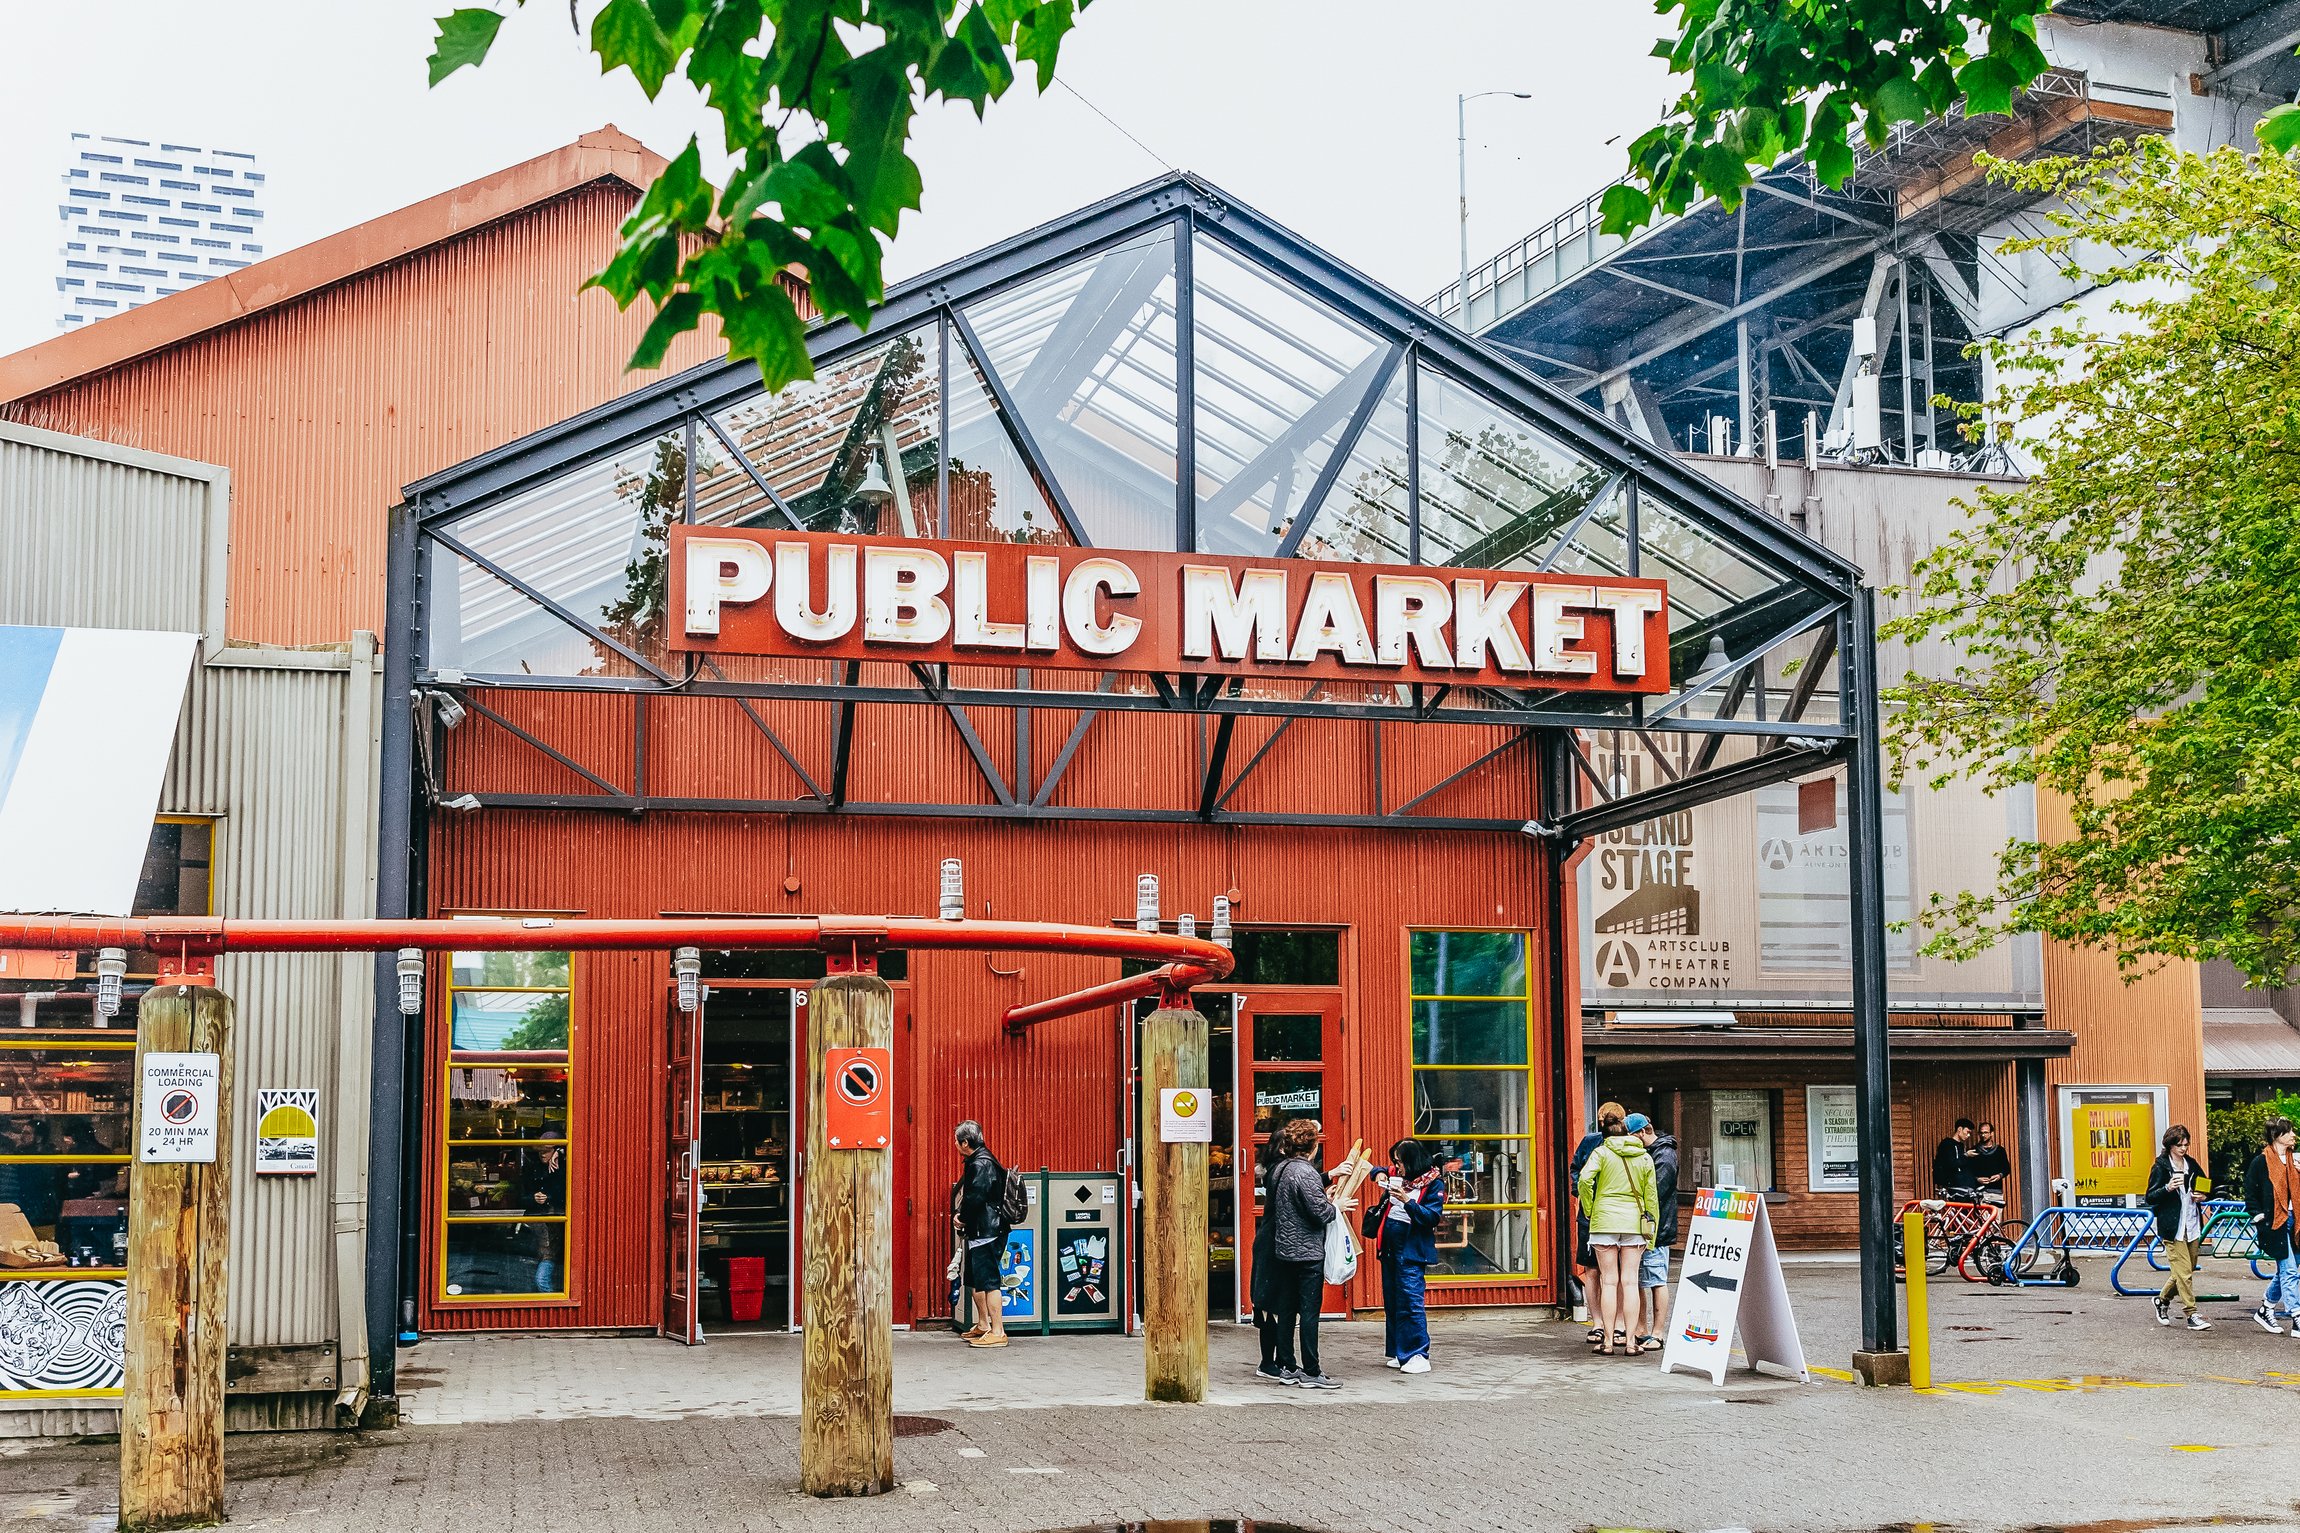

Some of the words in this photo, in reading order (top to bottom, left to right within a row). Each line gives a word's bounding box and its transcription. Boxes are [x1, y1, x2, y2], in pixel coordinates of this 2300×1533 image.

[685, 536, 1143, 655] PUBLIC
[1183, 563, 1662, 676] MARKET
[1600, 848, 1694, 890] STAGE
[1648, 939, 1730, 952] ARTSCLUB
[1648, 958, 1730, 970] THEATRE
[1649, 976, 1731, 988] COMPANY
[796, 990, 808, 1007] 6
[1237, 995, 1248, 1011] 7
[147, 1068, 214, 1078] COMMERCIAL
[158, 1078, 203, 1087] LOADING
[1257, 1096, 1280, 1105] PUBLIC
[1280, 1091, 1318, 1104] MARKET
[1828, 1117, 1849, 1125] SEASON
[1849, 1117, 1856, 1125] OF
[2089, 1110, 2129, 1128] MILLION
[148, 1127, 161, 1136] 20
[164, 1127, 184, 1136] MIN
[188, 1127, 209, 1136] MAX
[1723, 1122, 1757, 1135] OPEN
[1824, 1126, 1858, 1134] EXTRAORDIN
[162, 1137, 175, 1146] 24
[179, 1137, 194, 1146] HR
[2090, 1150, 2132, 1168] QUARTET
[1695, 1192, 1755, 1216] aquabus
[1689, 1233, 1742, 1262] Ferries
